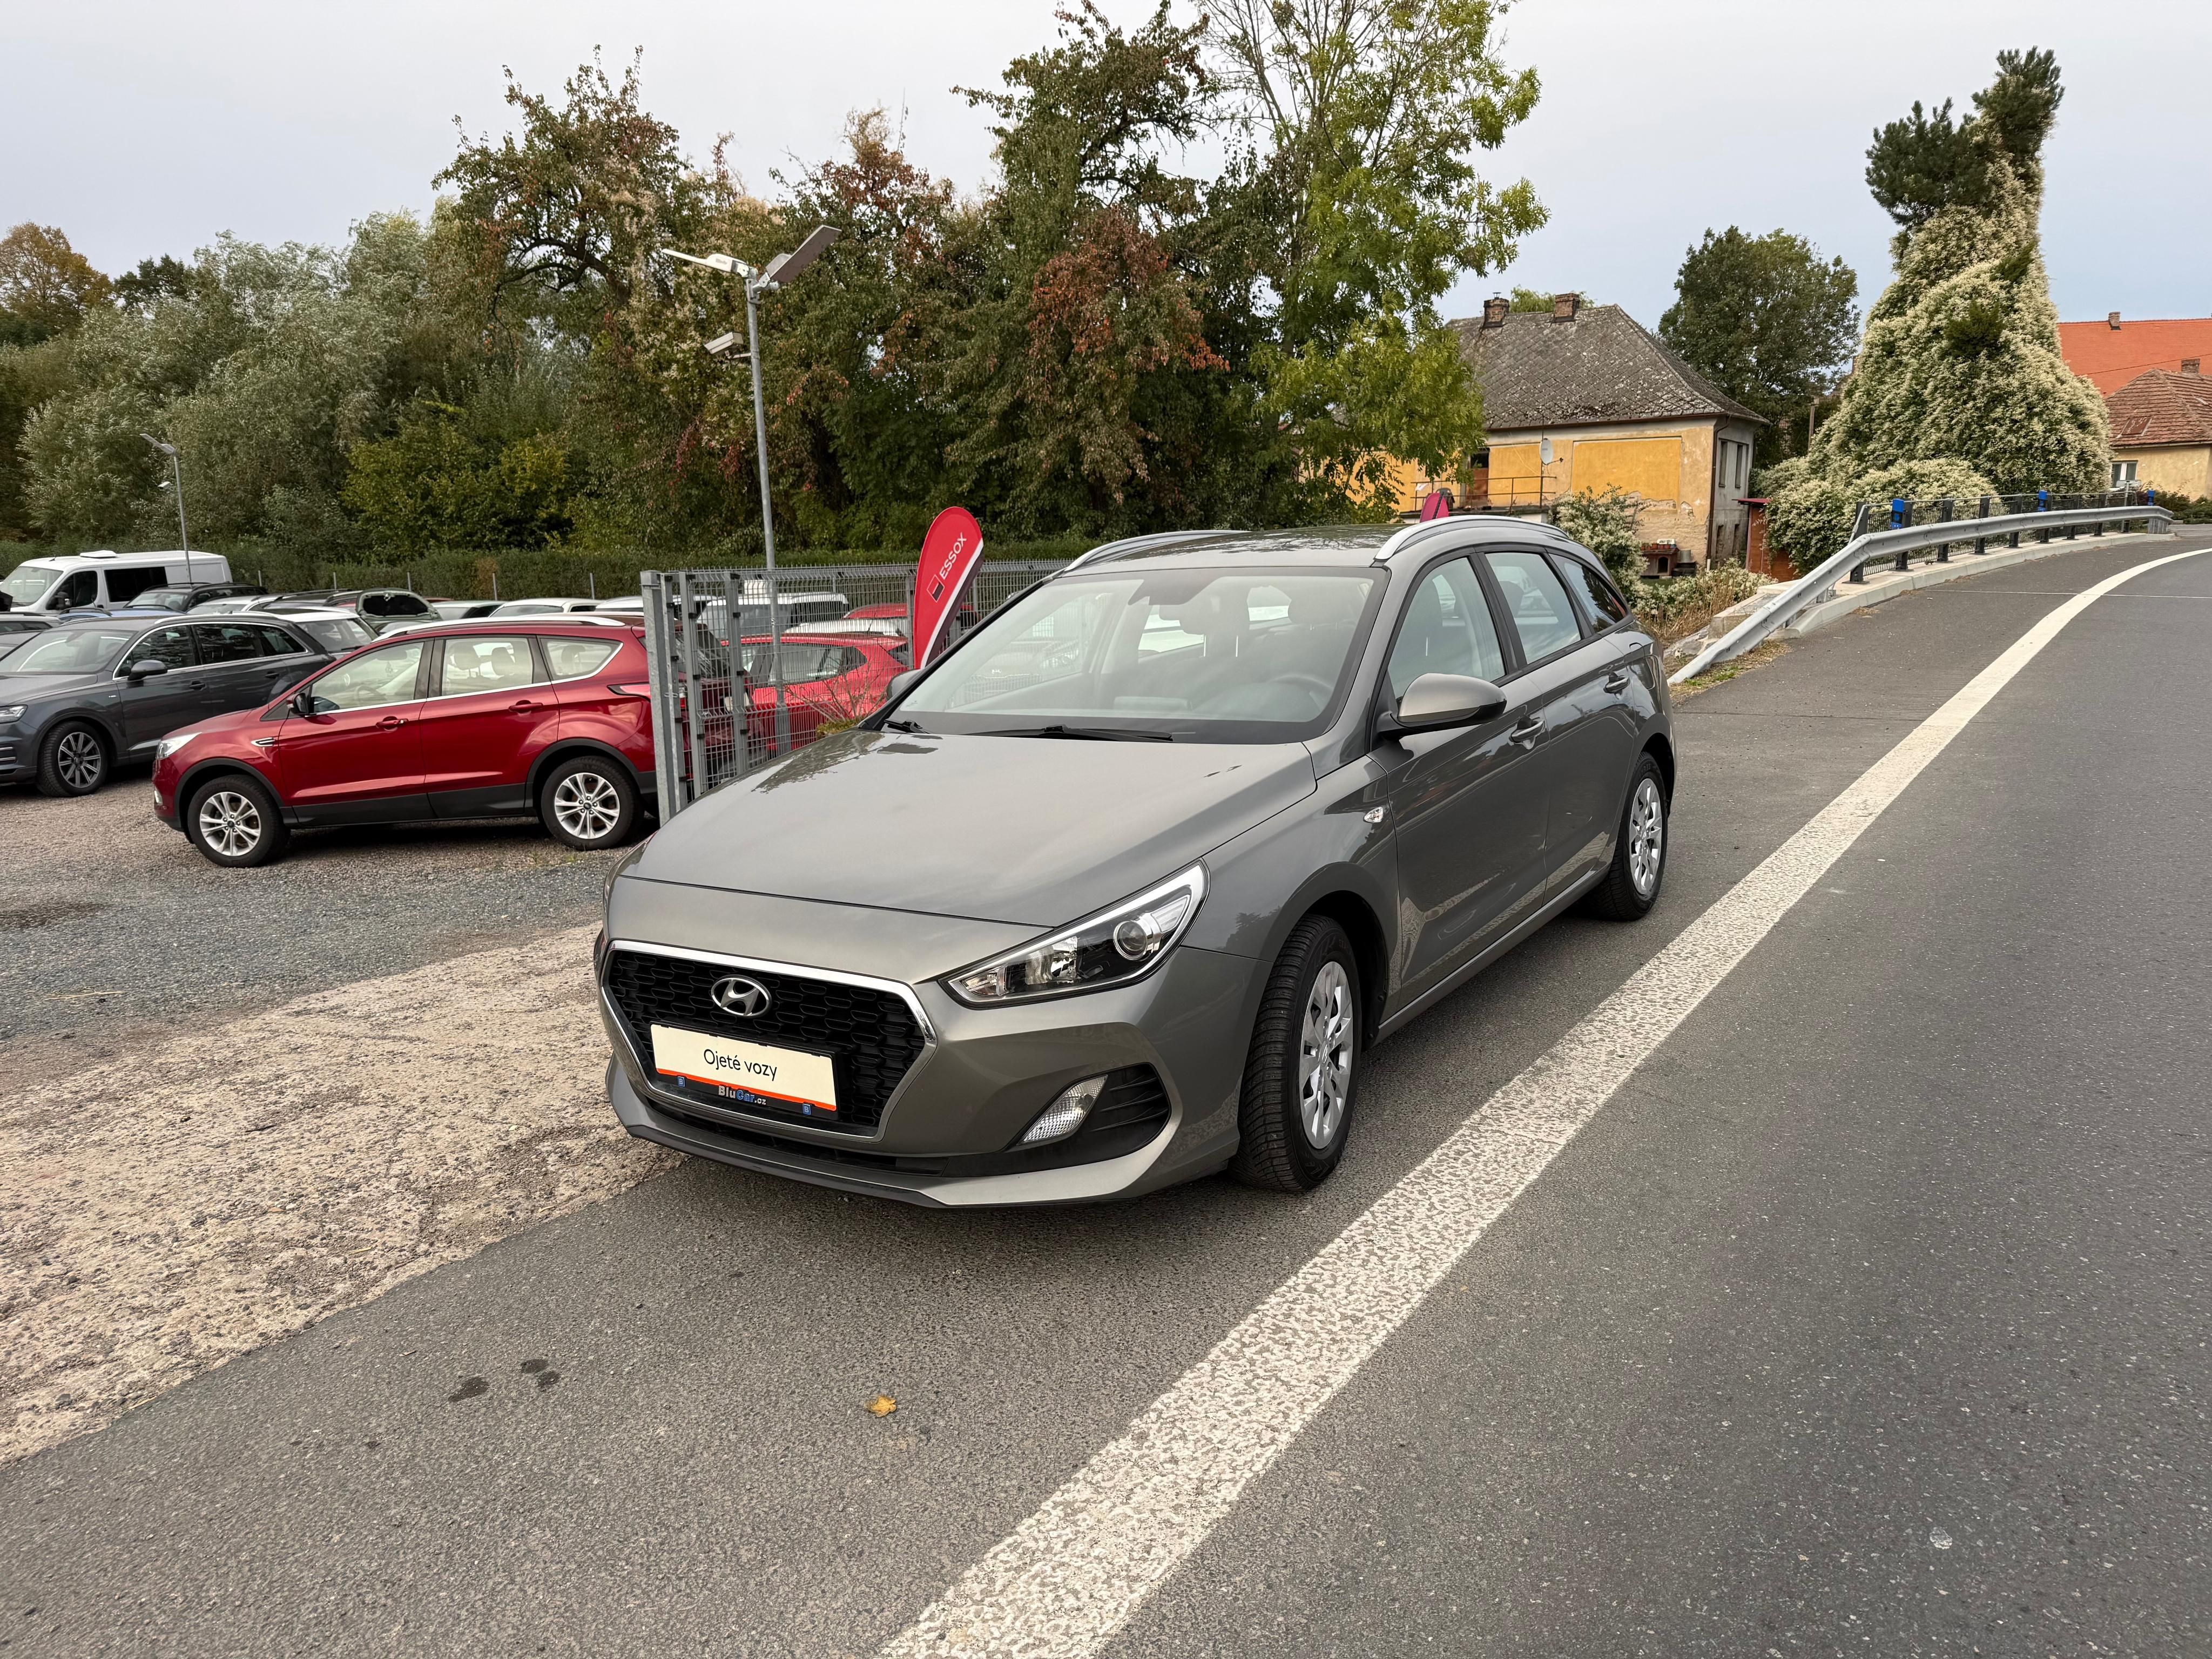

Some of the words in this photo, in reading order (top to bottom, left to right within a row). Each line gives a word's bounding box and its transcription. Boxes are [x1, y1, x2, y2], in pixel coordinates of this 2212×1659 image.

[940, 532, 967, 580] ESSOX
[704, 1049, 740, 1070] Ojeté
[744, 1061, 777, 1081] vozy
[718, 1085, 766, 1105] BluCar.cz
